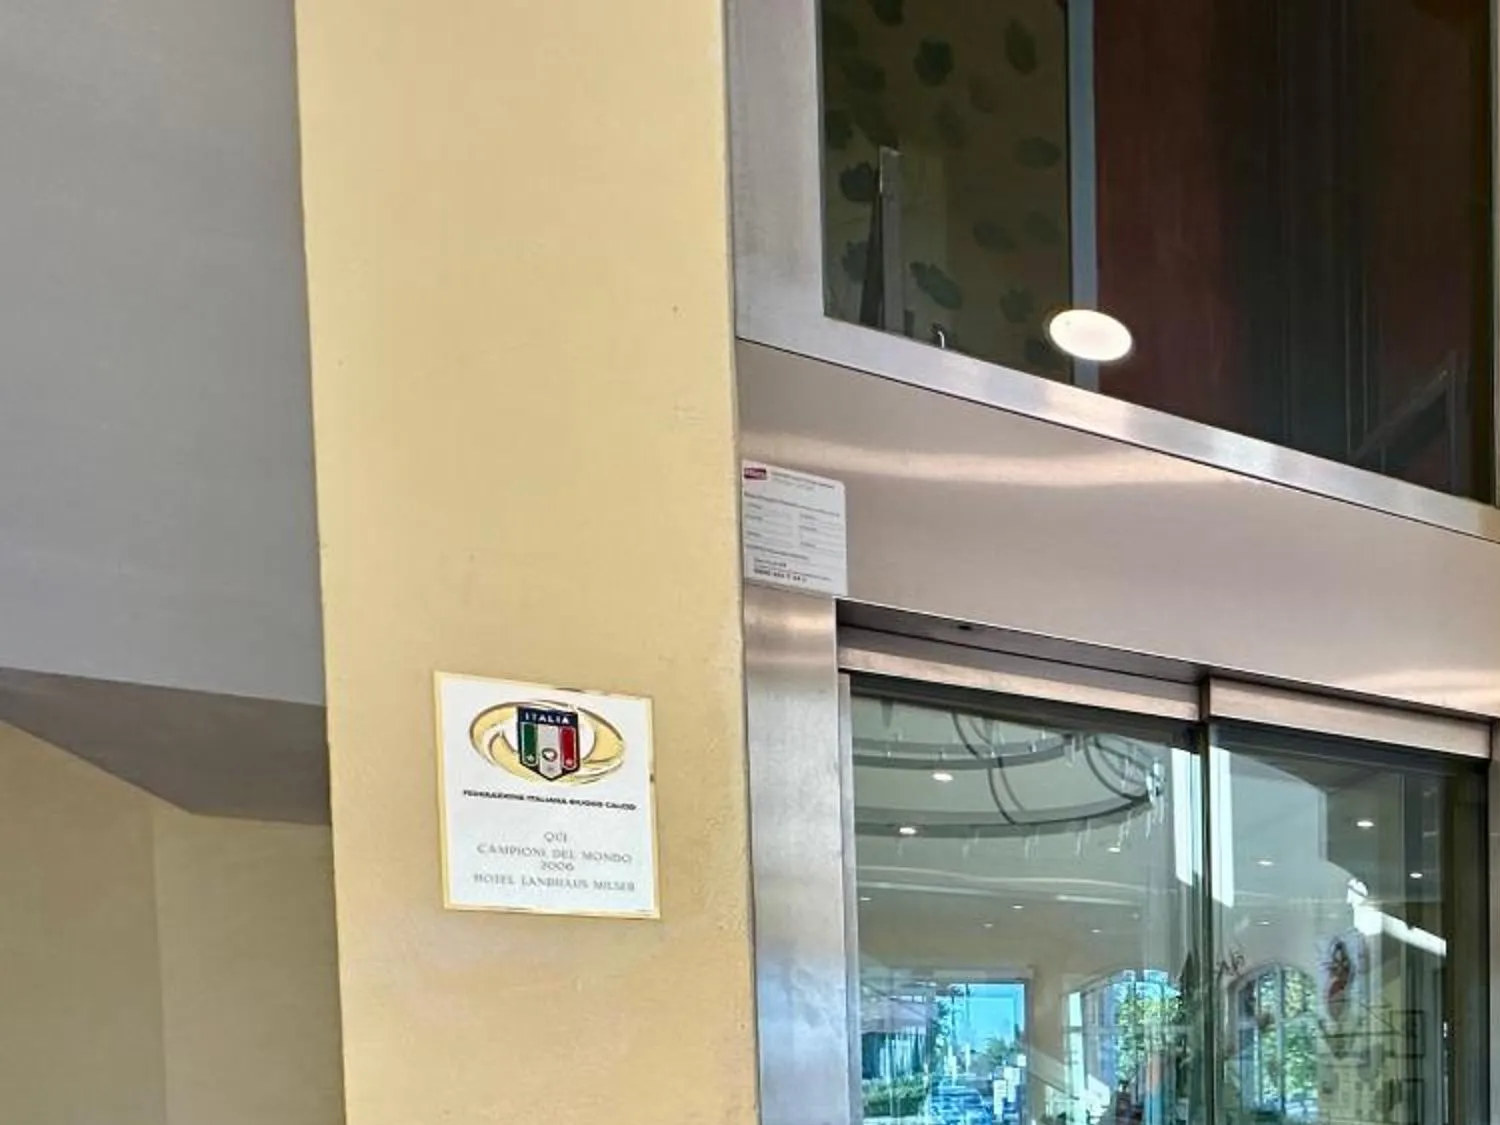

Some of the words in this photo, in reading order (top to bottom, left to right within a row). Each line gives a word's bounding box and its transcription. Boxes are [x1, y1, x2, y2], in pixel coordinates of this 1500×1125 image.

[525, 711, 569, 724] ITALIA
[551, 849, 575, 860] DEL
[581, 850, 633, 864] MONDO
[540, 861, 576, 872] 2006
[473, 873, 516, 887] HOTEL
